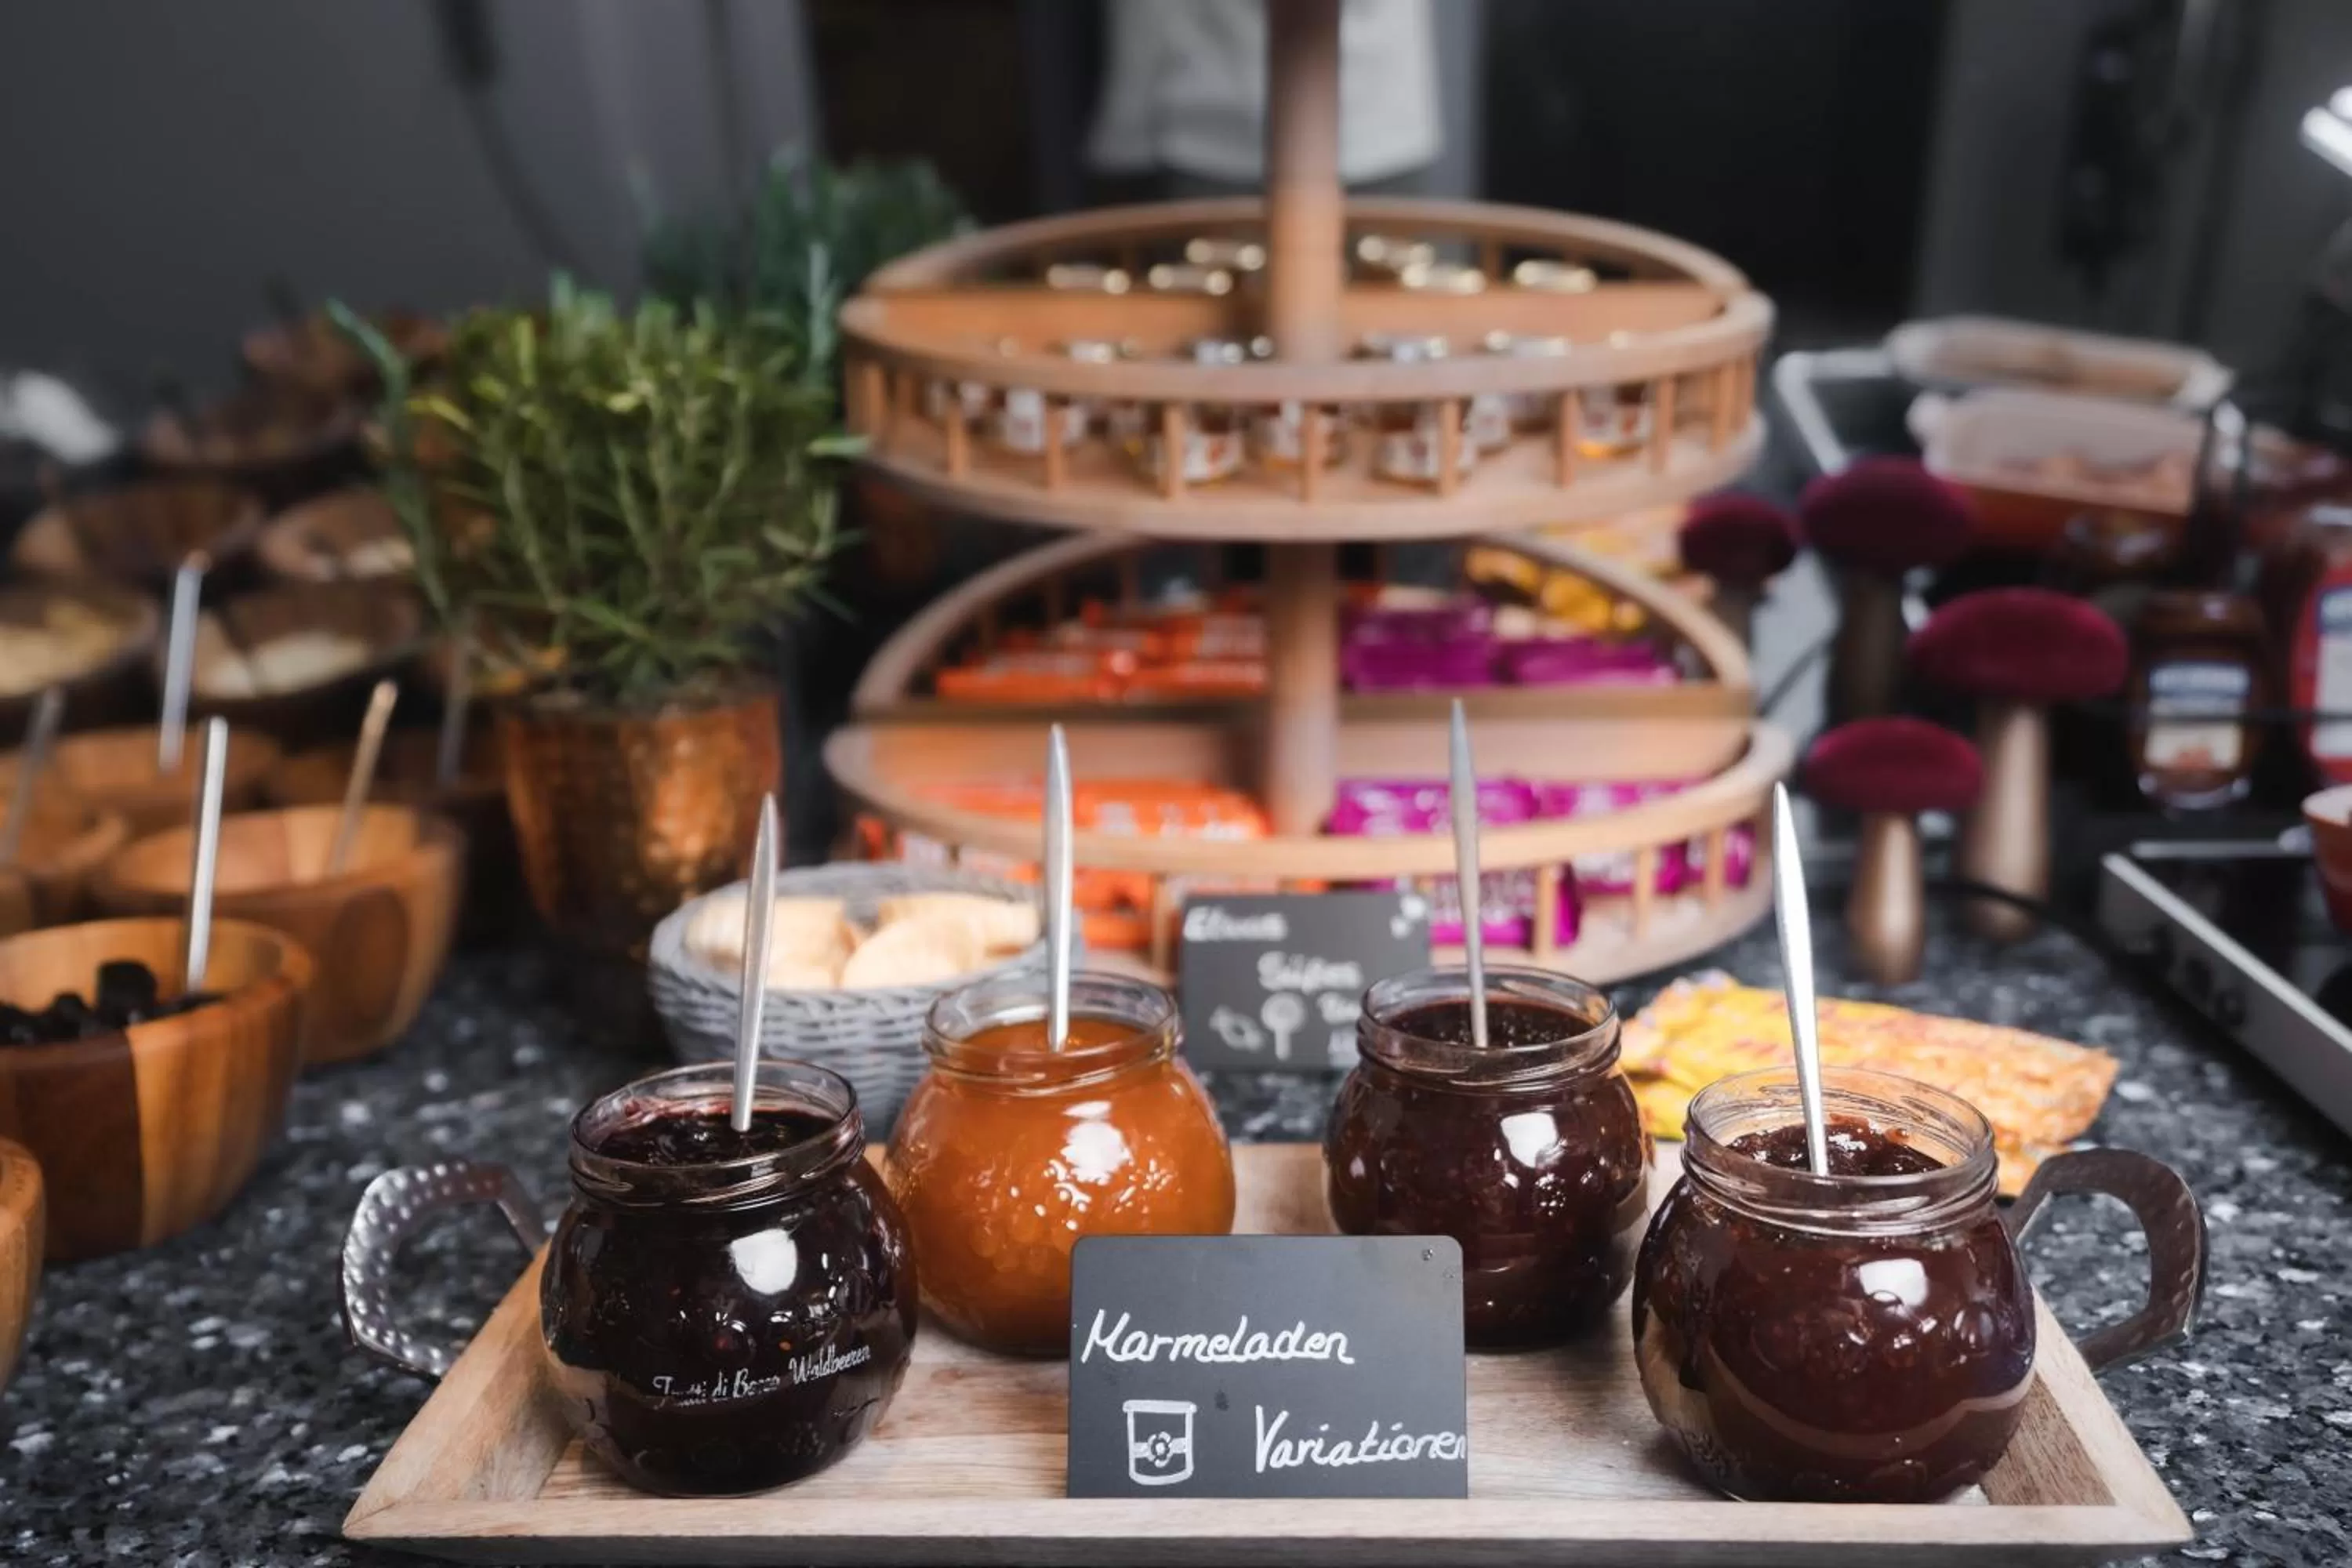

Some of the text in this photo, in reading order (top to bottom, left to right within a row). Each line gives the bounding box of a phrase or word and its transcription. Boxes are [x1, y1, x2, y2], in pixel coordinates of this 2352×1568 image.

[1080, 1308, 1356, 1363] Marmeladen
[712, 1371, 728, 1399] di
[787, 1342, 872, 1385] Waldbeeren
